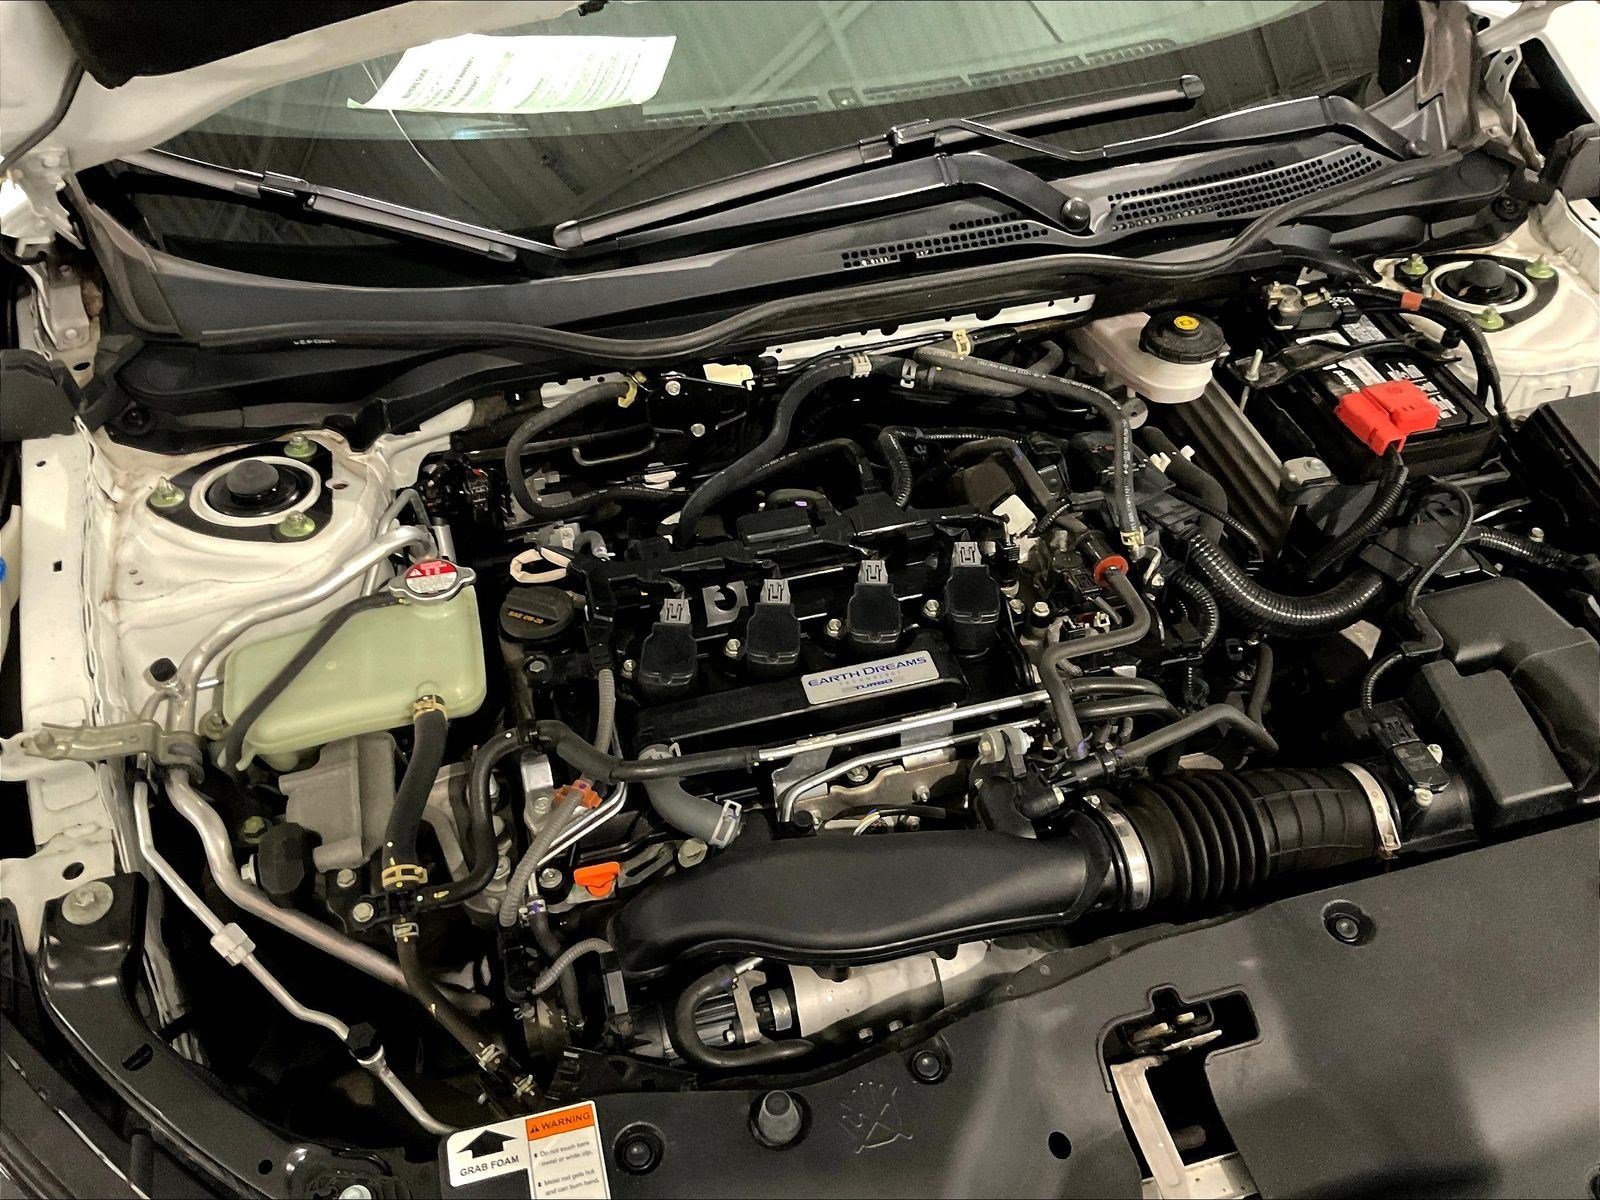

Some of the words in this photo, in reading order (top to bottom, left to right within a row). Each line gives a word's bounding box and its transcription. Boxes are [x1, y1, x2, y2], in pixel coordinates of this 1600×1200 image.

[808, 670, 860, 687] EARTH
[863, 656, 927, 676] DREAMS
[855, 678, 893, 690] TURBO
[541, 1112, 591, 1131] WARNING
[460, 1161, 488, 1177] GRAB
[490, 1154, 520, 1169] FOAM
